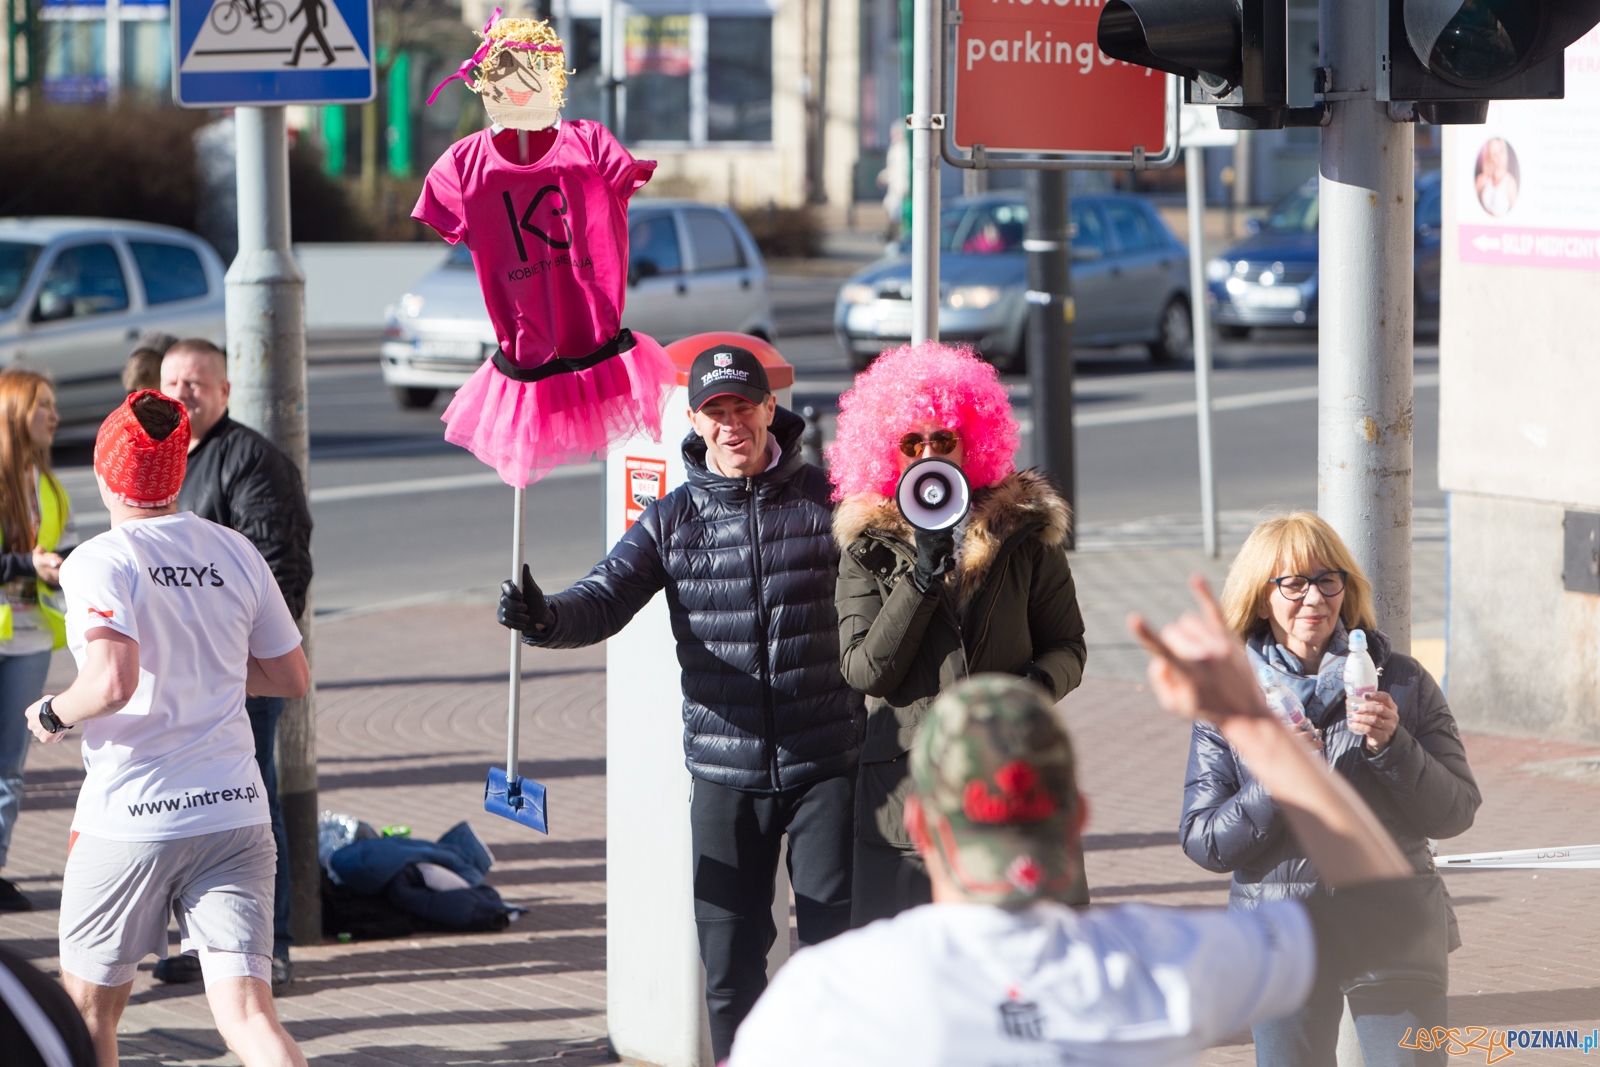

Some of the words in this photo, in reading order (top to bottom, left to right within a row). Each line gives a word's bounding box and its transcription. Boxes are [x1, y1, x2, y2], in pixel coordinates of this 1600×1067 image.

[966, 30, 1152, 77] parkingo
[508, 260, 552, 282] KOBIETY
[148, 563, 225, 587] KRZYŚ
[128, 782, 260, 817] www.intrex.pl
